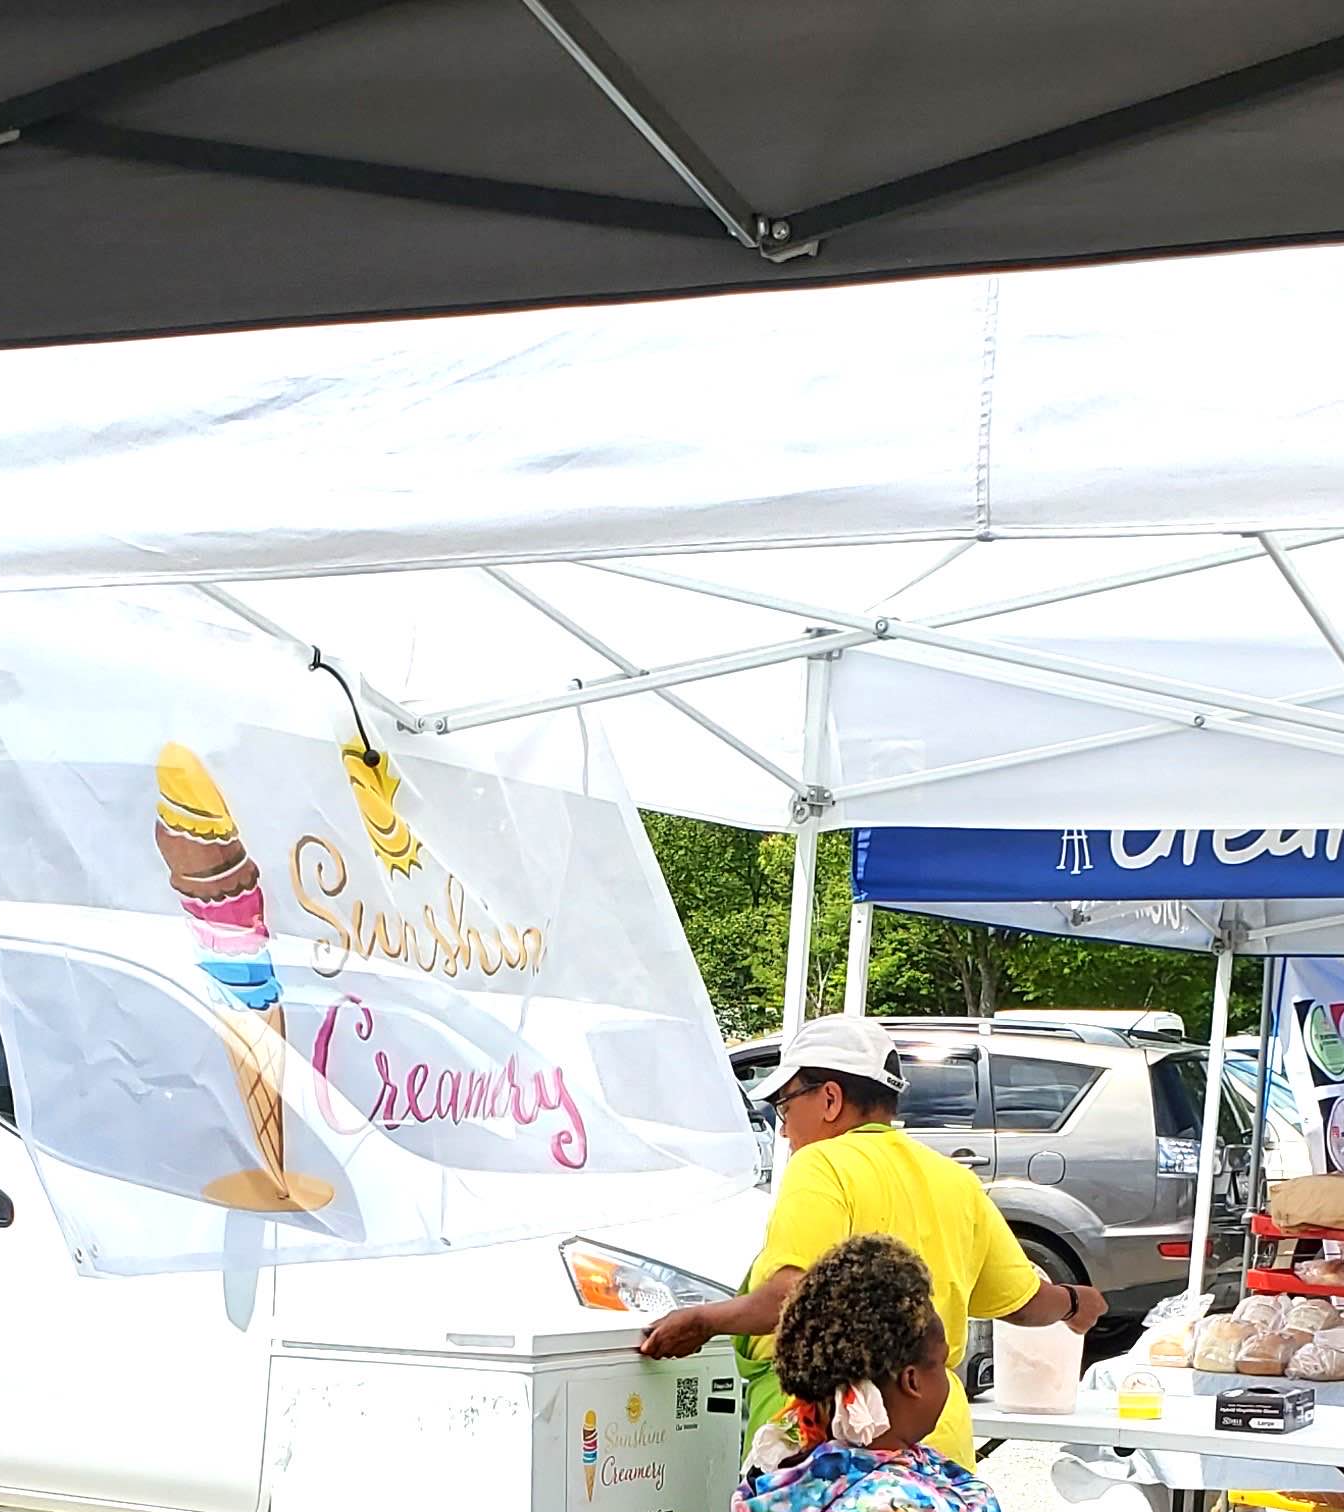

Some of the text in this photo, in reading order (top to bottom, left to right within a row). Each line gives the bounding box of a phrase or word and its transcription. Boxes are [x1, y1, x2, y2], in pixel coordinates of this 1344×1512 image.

[289, 834, 552, 978] Sunshin
[604, 1420, 668, 1454] Sunshine
[601, 1455, 666, 1491] Creamery
